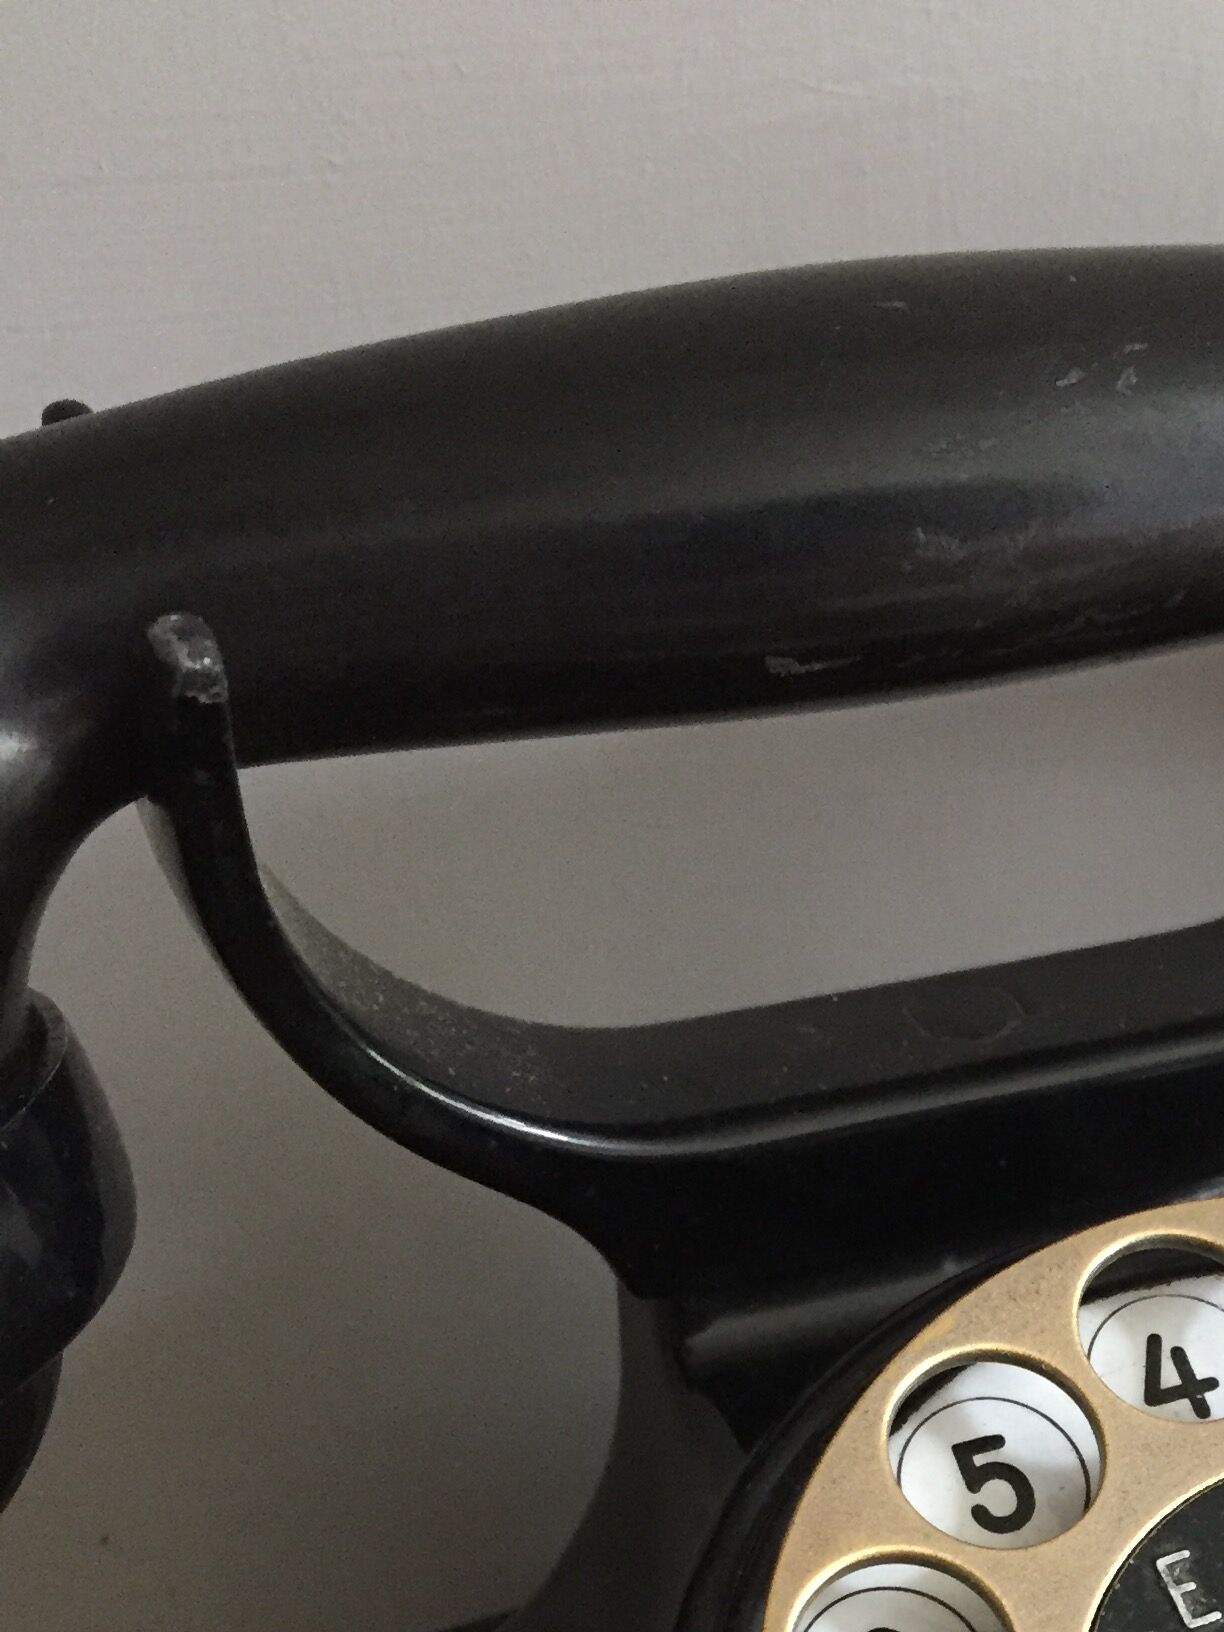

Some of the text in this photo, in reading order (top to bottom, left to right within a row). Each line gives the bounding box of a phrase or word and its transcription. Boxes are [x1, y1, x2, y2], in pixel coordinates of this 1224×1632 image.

[1144, 1333, 1219, 1420] 4
[952, 1434, 1036, 1534] 5
[1156, 1550, 1222, 1629] E
